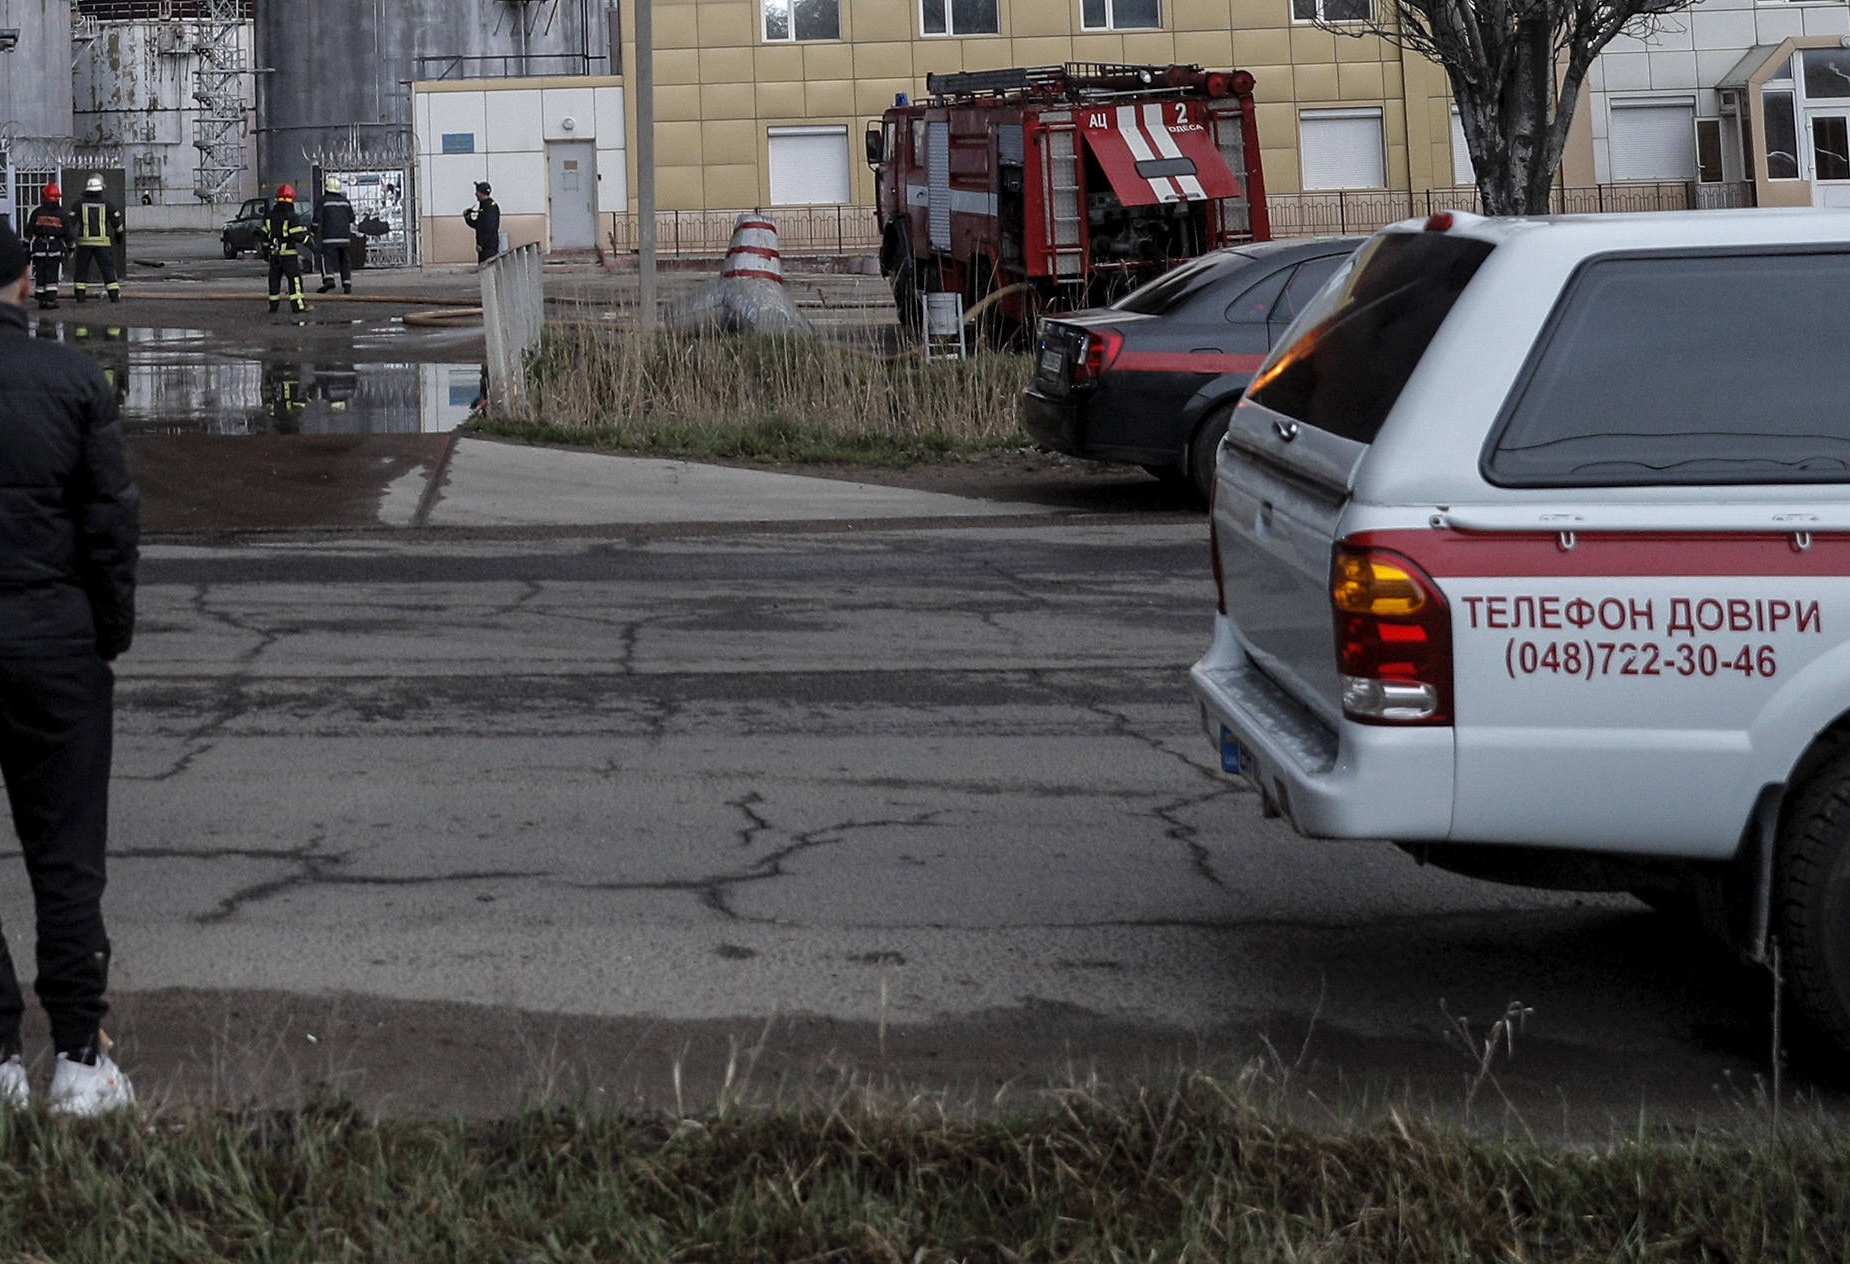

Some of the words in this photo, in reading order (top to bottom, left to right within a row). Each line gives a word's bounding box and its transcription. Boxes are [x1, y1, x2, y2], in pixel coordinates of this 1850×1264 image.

[1089, 113, 1108, 130] АЦ
[1175, 103, 1188, 123] 2
[1168, 124, 1204, 133] ОДЕСА
[1461, 595, 1653, 630] ТЕЛЕФОН
[1666, 597, 1822, 637] ДОВІРИ
[1505, 637, 1777, 680] (048)722-30-46
